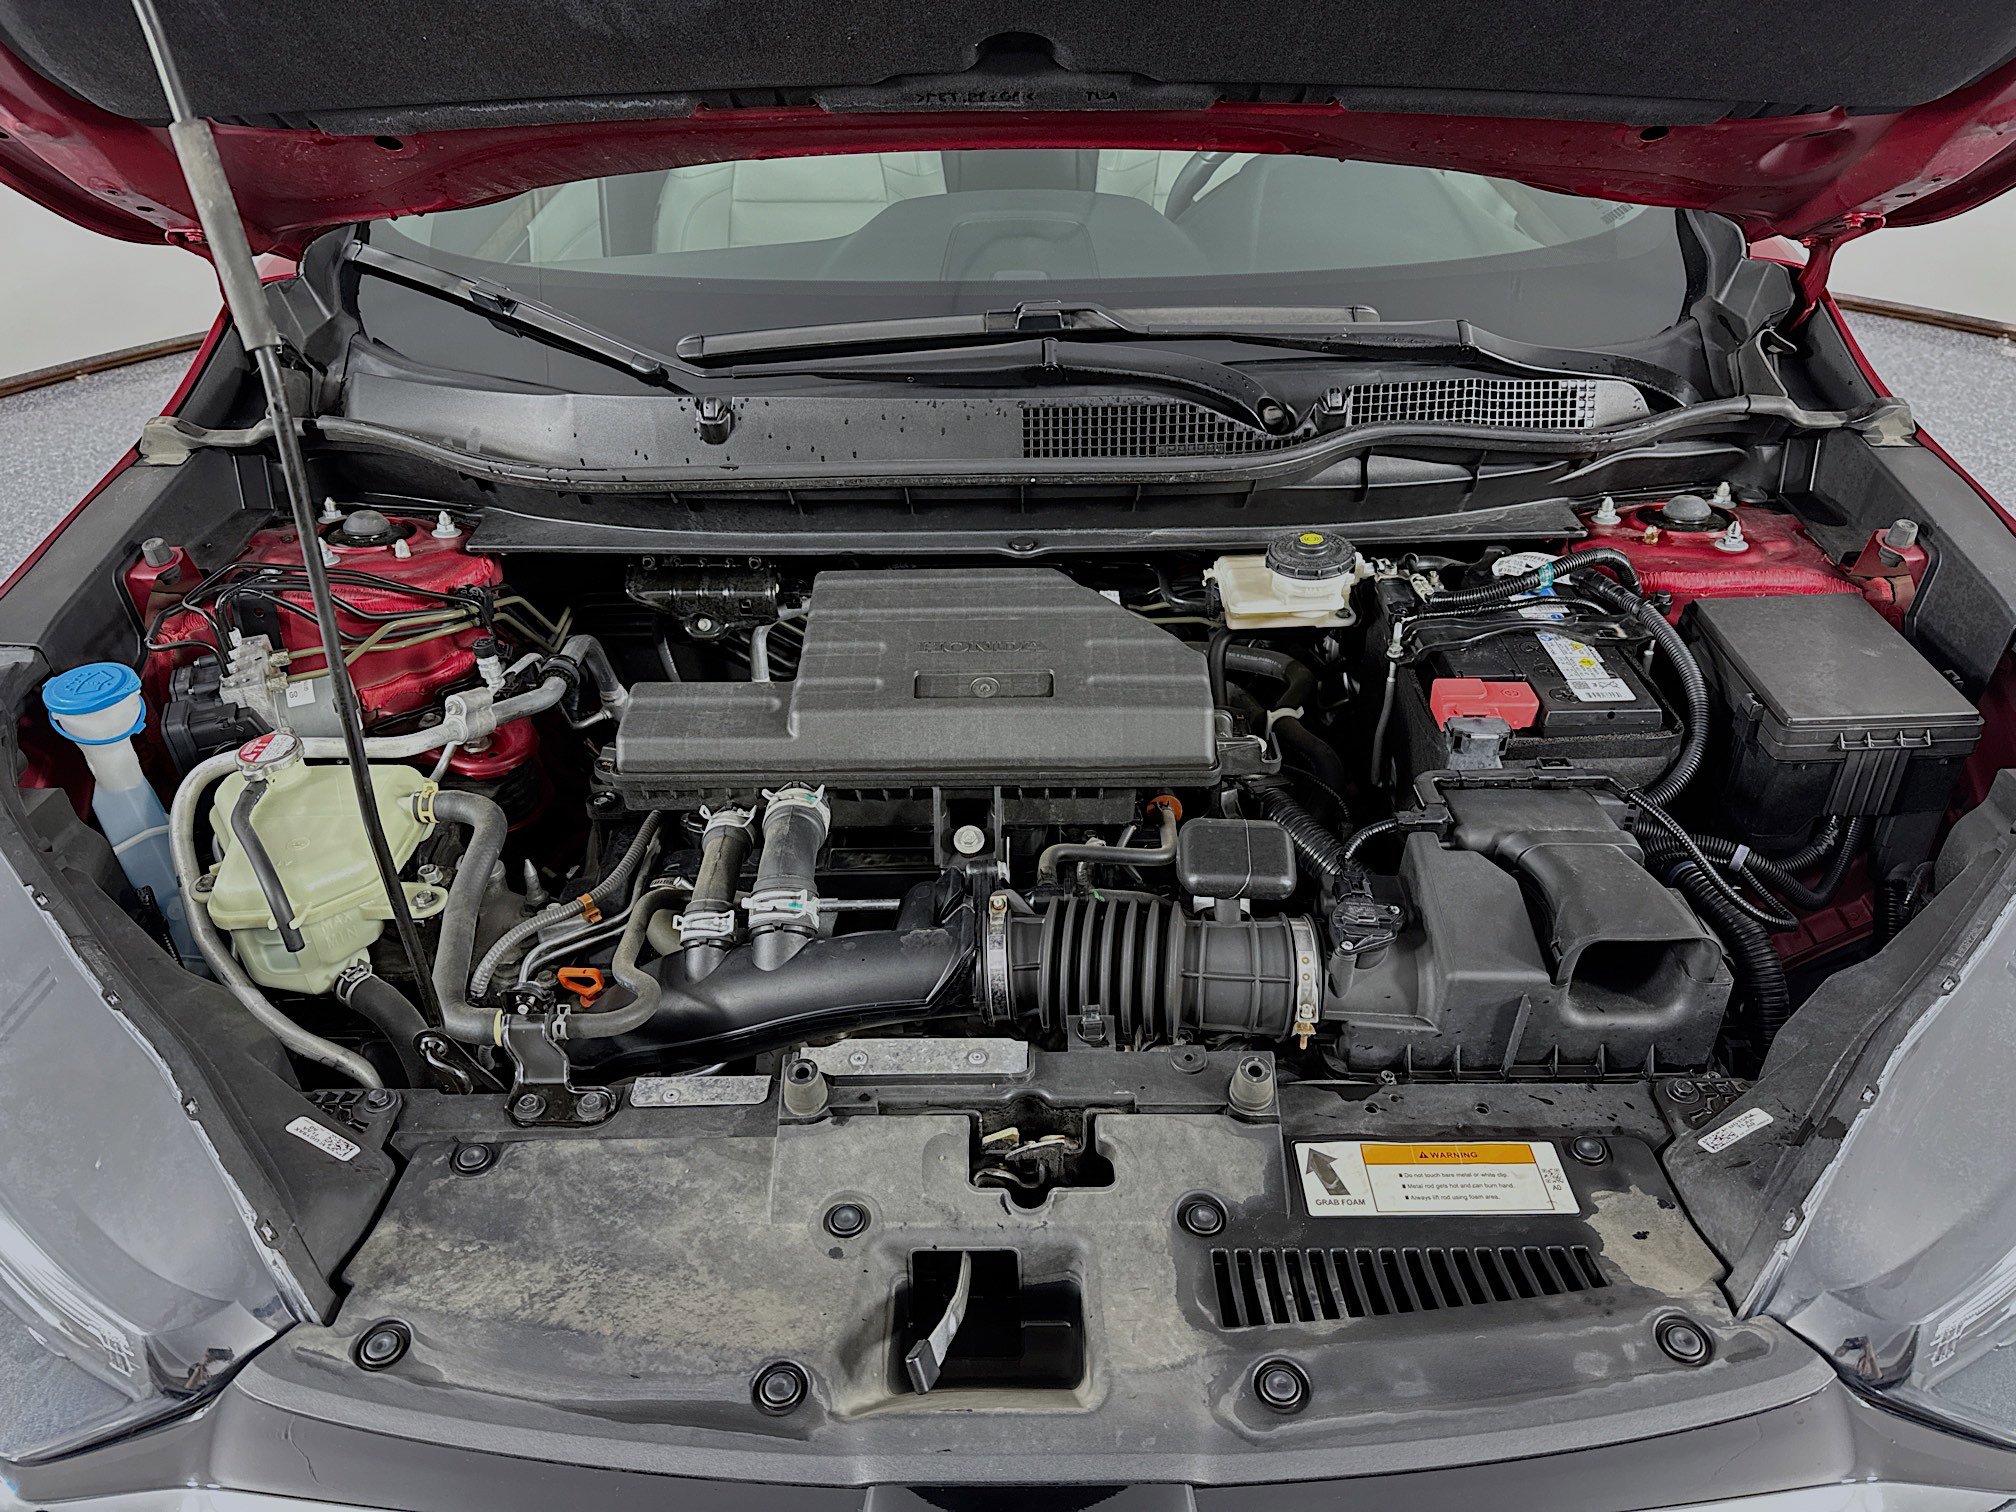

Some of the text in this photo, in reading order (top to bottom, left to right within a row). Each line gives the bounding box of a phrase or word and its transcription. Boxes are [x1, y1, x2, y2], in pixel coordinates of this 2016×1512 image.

[914, 641, 1050, 653] HONDA
[320, 912, 353, 936] MAX
[325, 925, 359, 950] MIN
